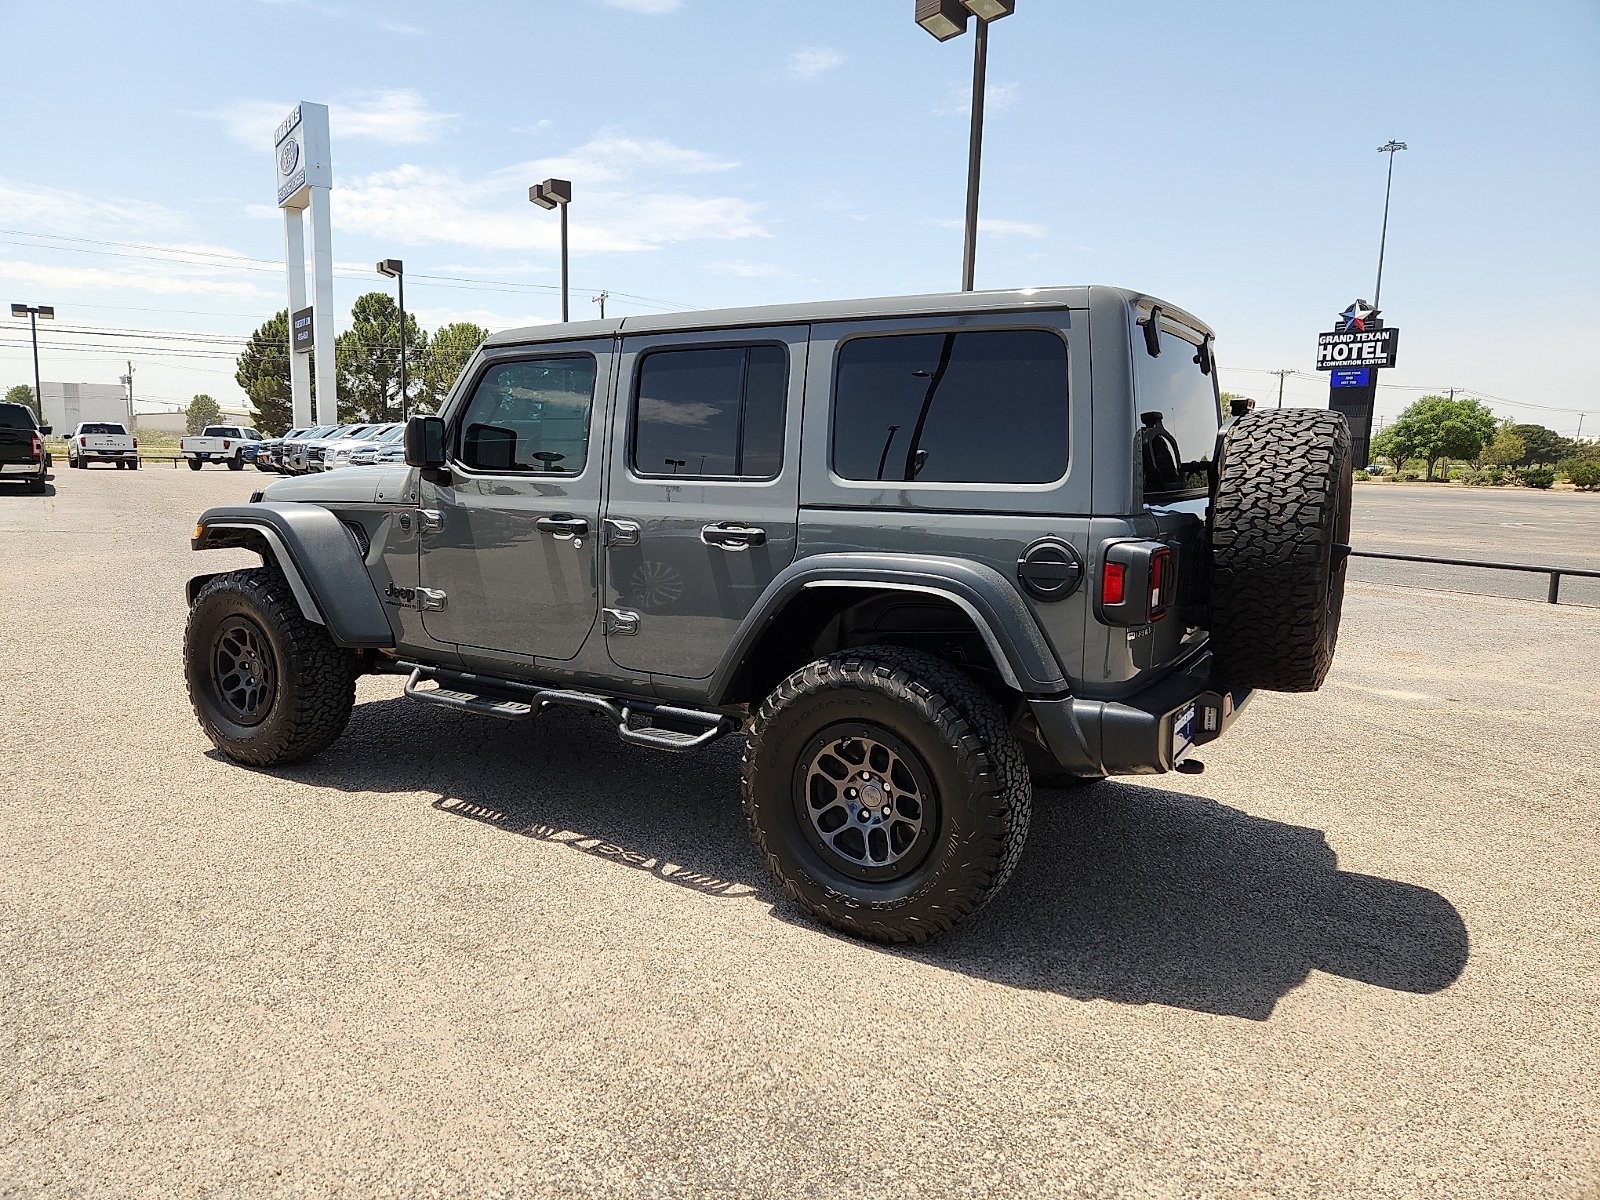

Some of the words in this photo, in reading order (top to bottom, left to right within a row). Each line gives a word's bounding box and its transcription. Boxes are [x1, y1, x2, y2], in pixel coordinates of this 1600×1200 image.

[1320, 334, 1354, 344] GRAND
[1356, 332, 1390, 341] TEXAN
[1318, 341, 1388, 361] HOTEL
[1323, 359, 1362, 367] CONVENTION
[384, 581, 415, 602] Jeep
